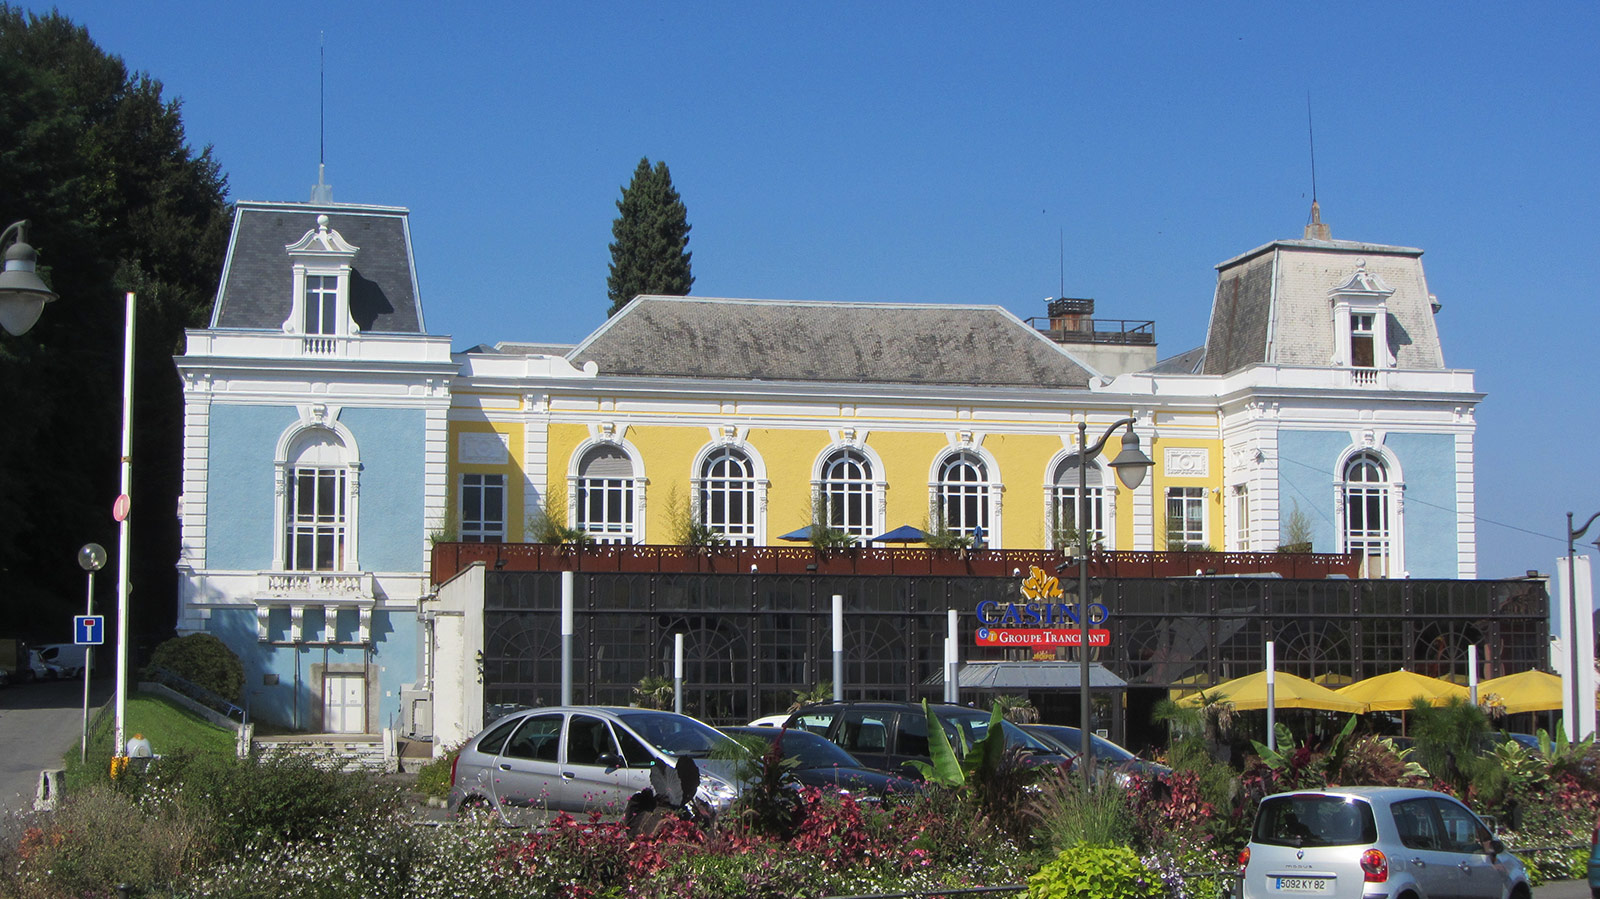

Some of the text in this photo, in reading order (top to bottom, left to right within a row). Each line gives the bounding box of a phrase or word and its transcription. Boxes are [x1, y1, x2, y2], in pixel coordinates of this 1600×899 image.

[976, 600, 1109, 625] CASINO
[999, 631, 1042, 643] GROUPE
[1280, 879, 1325, 889] 5092 KY 82
